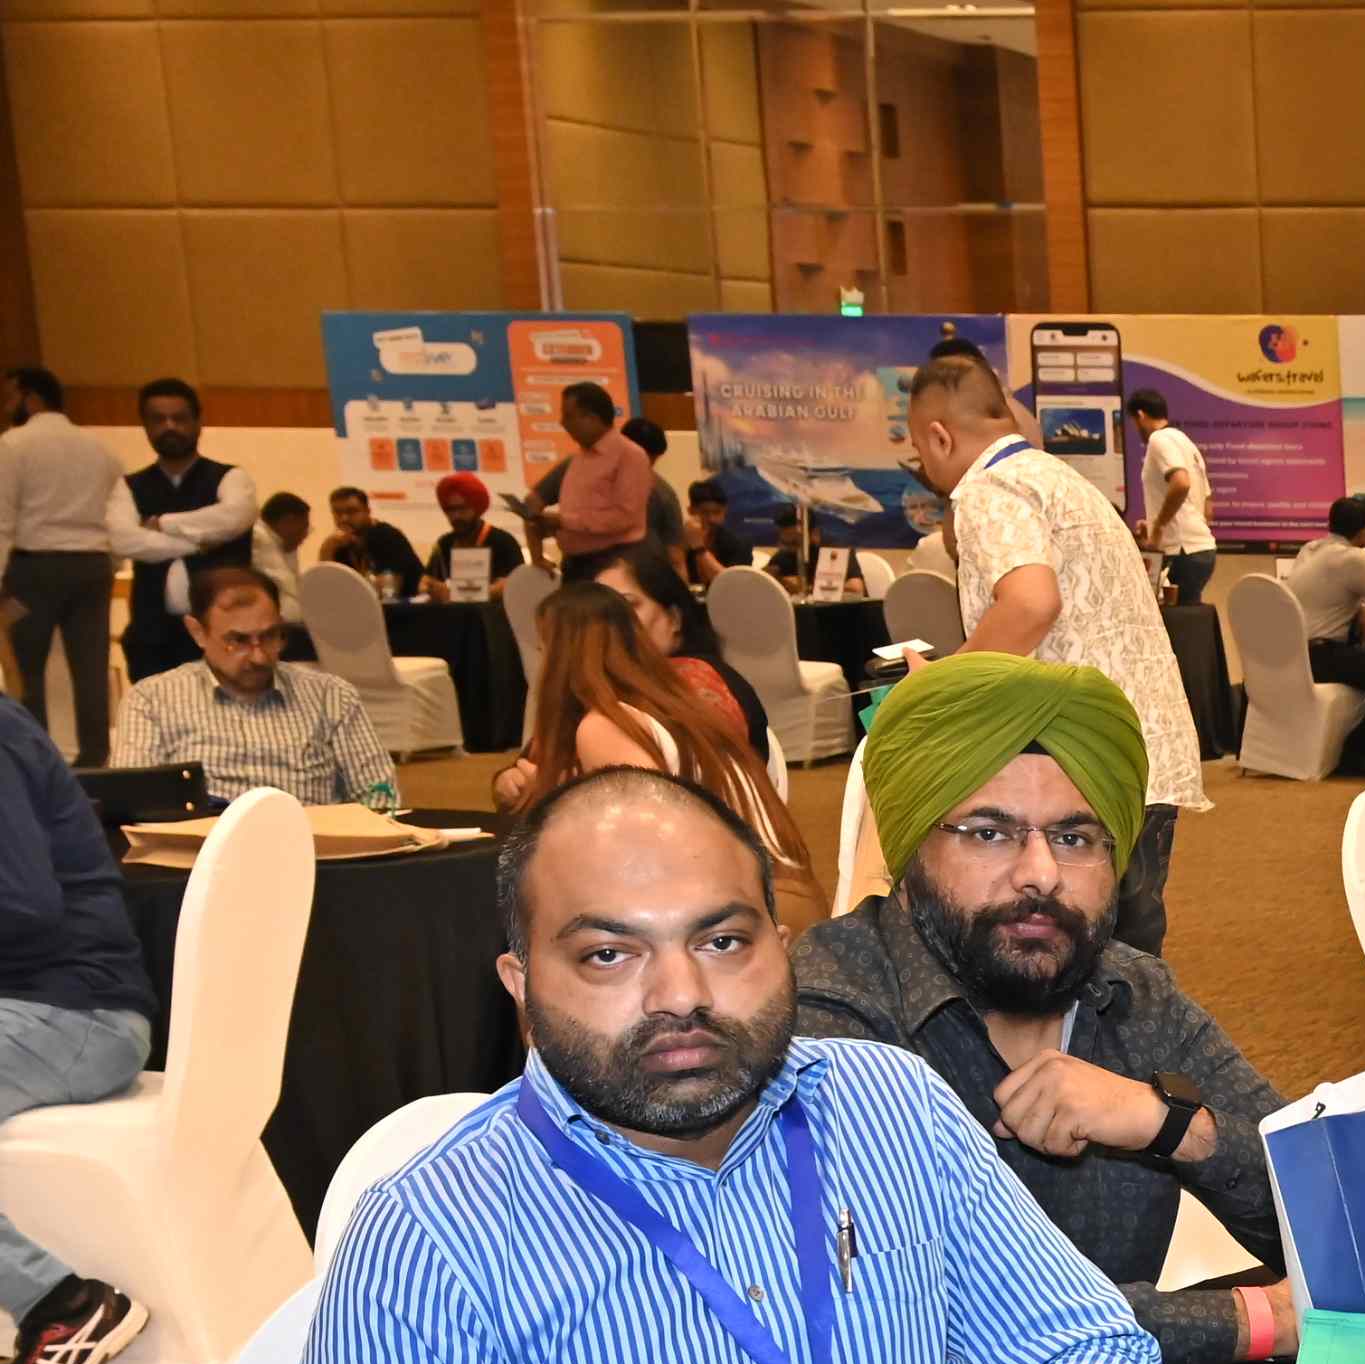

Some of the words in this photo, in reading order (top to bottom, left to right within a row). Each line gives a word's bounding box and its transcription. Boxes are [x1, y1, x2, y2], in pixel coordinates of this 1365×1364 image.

[720, 383, 801, 399] CRUISING
[809, 384, 828, 399] IN
[732, 404, 809, 420] ARABIAN
